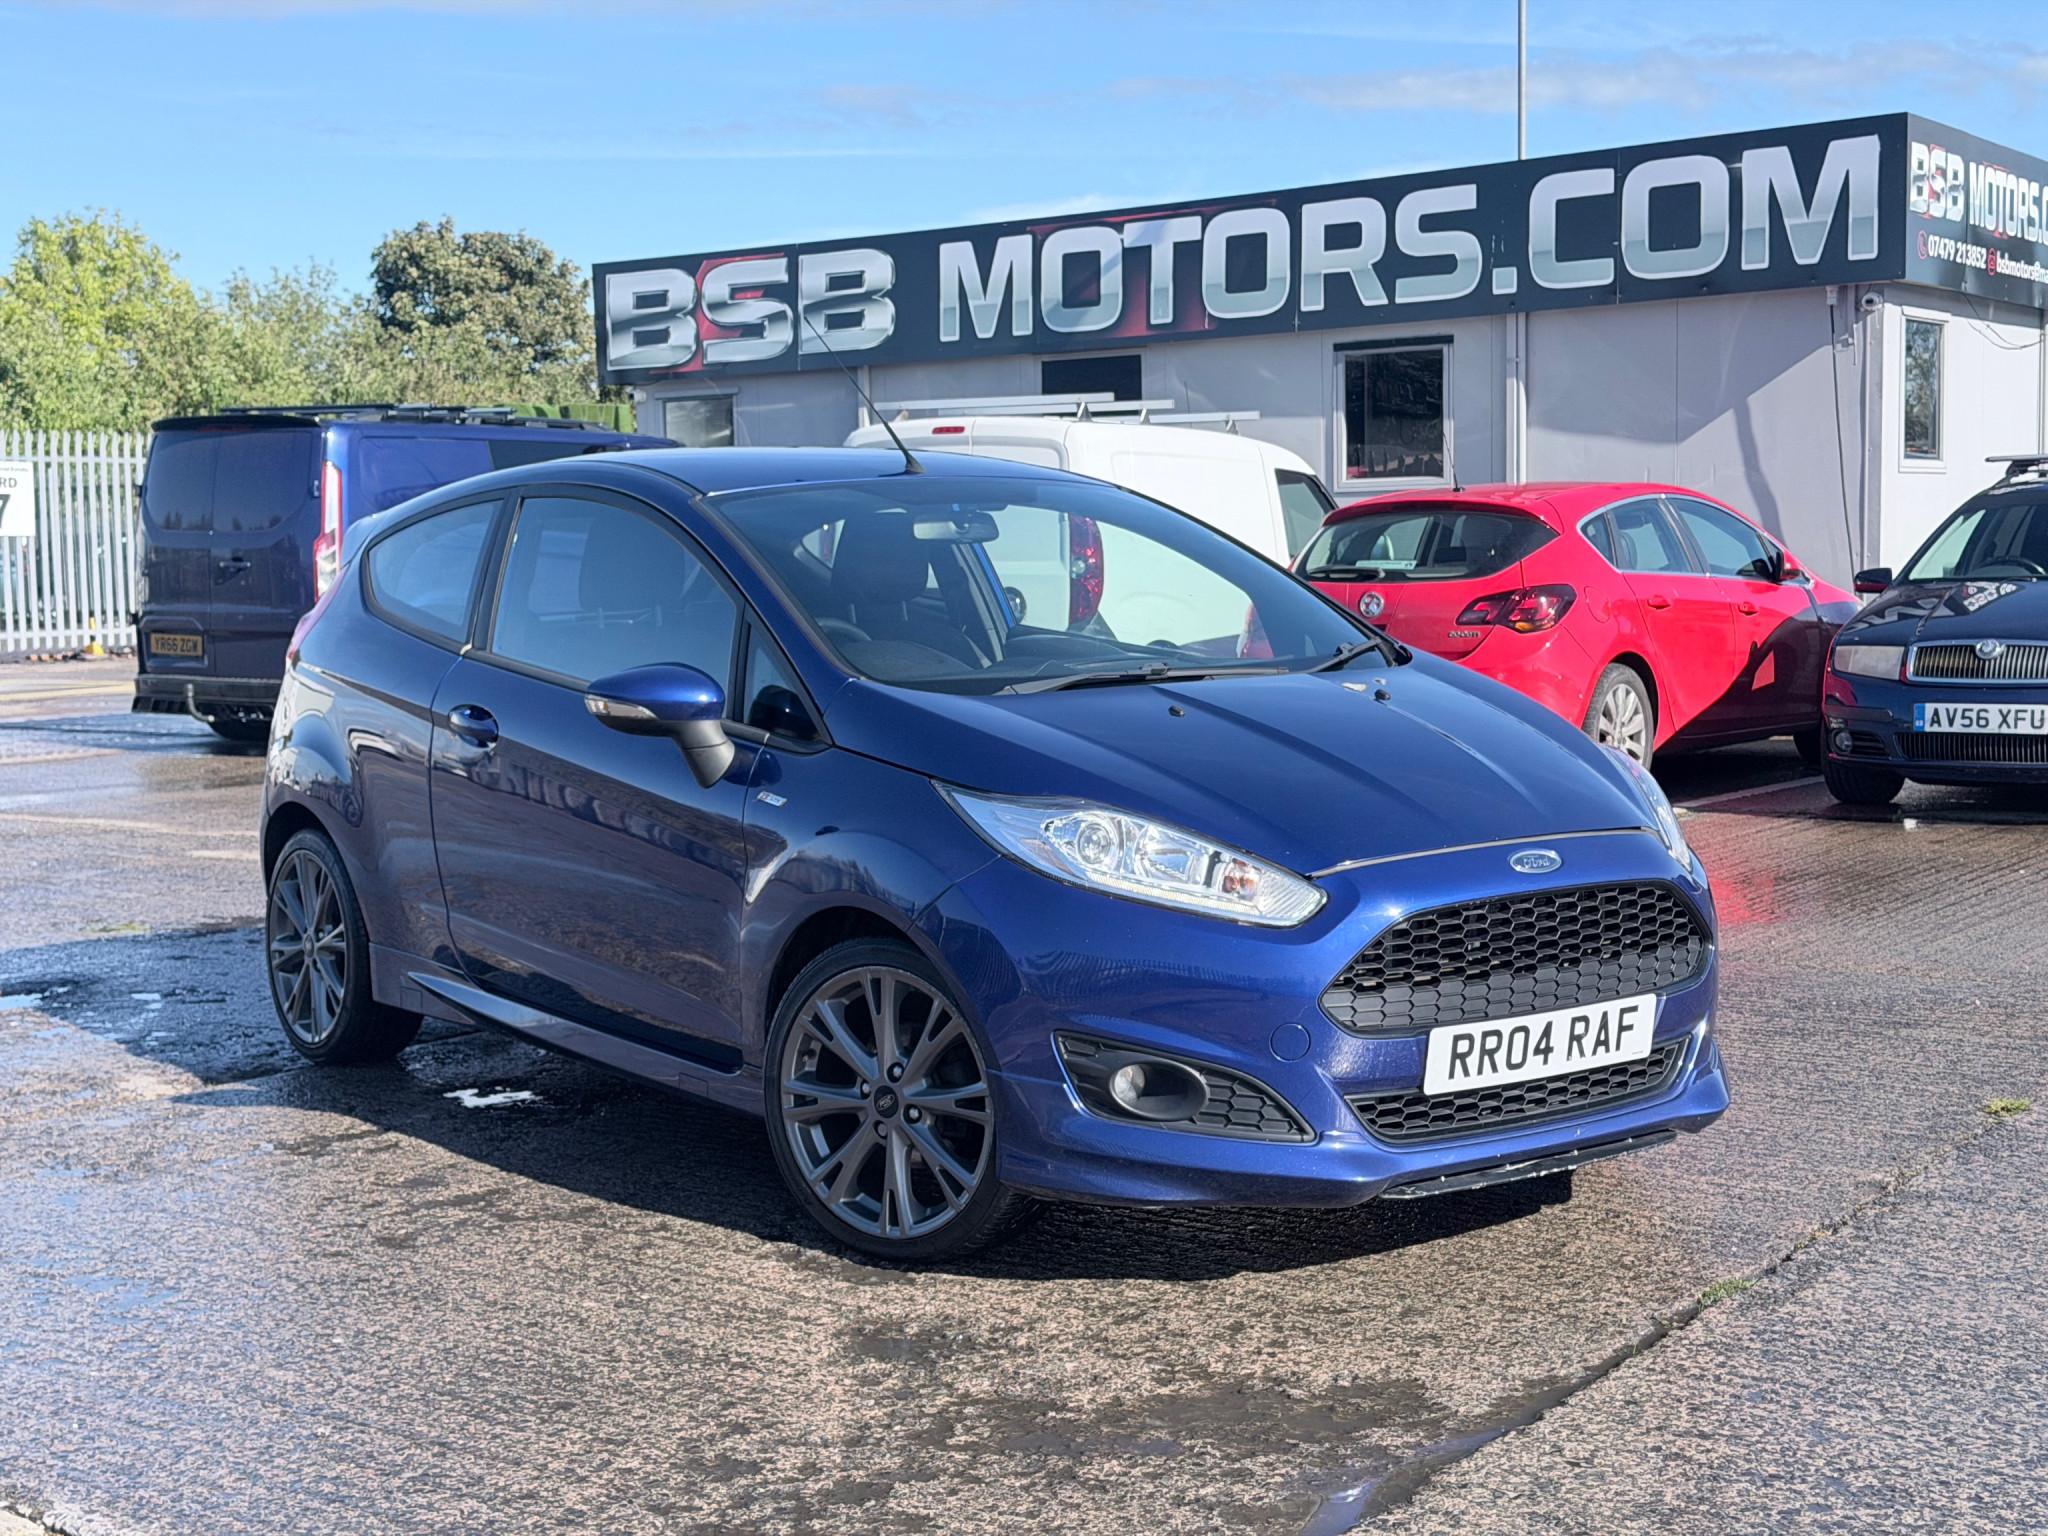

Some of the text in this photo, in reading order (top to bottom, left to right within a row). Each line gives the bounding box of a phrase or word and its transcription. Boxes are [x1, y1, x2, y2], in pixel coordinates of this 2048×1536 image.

[1909, 141, 1965, 222] BSB
[606, 134, 1881, 371] BSB MOTORS.COM
[1928, 234, 1987, 269] 07479 213852
[1929, 707, 2046, 730] AV56 XFU
[1448, 1005, 1640, 1080] RR04 RAF
